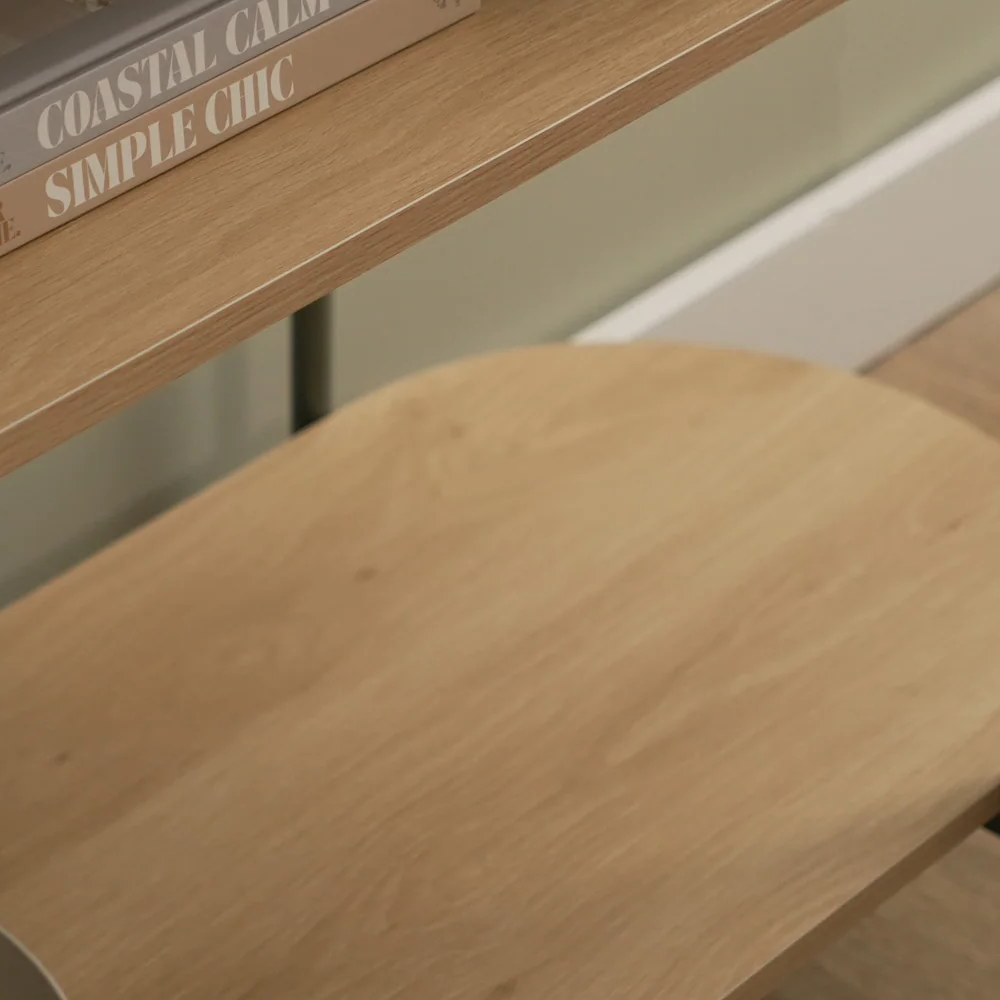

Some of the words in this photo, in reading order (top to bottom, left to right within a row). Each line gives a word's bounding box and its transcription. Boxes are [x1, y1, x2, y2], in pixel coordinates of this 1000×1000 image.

[37, 29, 217, 150] COASTAL
[45, 103, 198, 218] SIMPLE
[205, 54, 295, 135] CHIC
